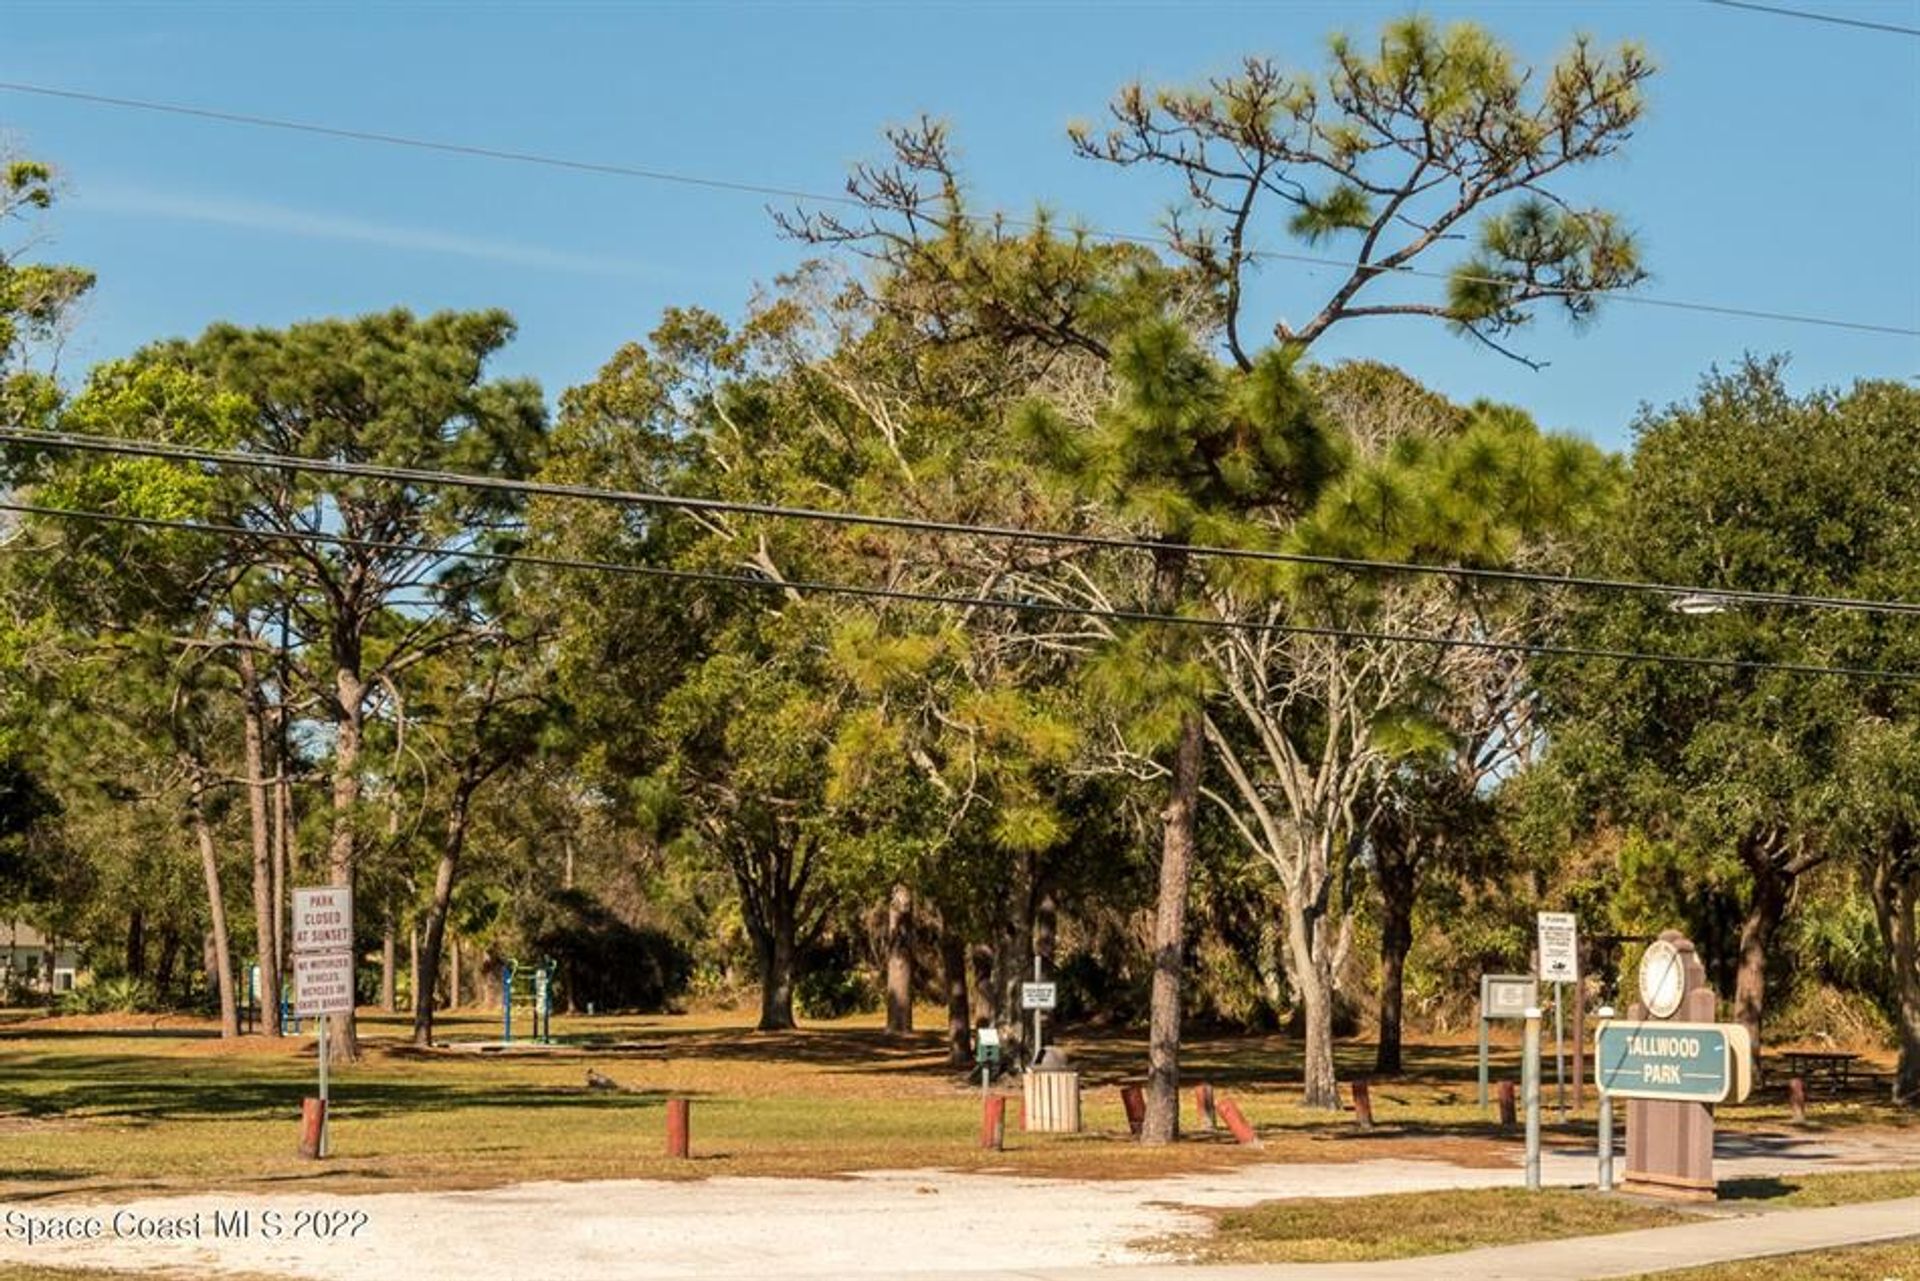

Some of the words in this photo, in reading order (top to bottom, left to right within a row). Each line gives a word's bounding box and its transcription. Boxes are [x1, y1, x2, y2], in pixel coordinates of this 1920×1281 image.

[310, 896, 334, 907] PARK
[304, 911, 341, 925] CLOSED
[297, 931, 308, 941] AT
[312, 928, 348, 942] SUNSET
[1626, 1036, 1700, 1058] TALLWOOD
[1643, 1064, 1681, 1084] PARK
